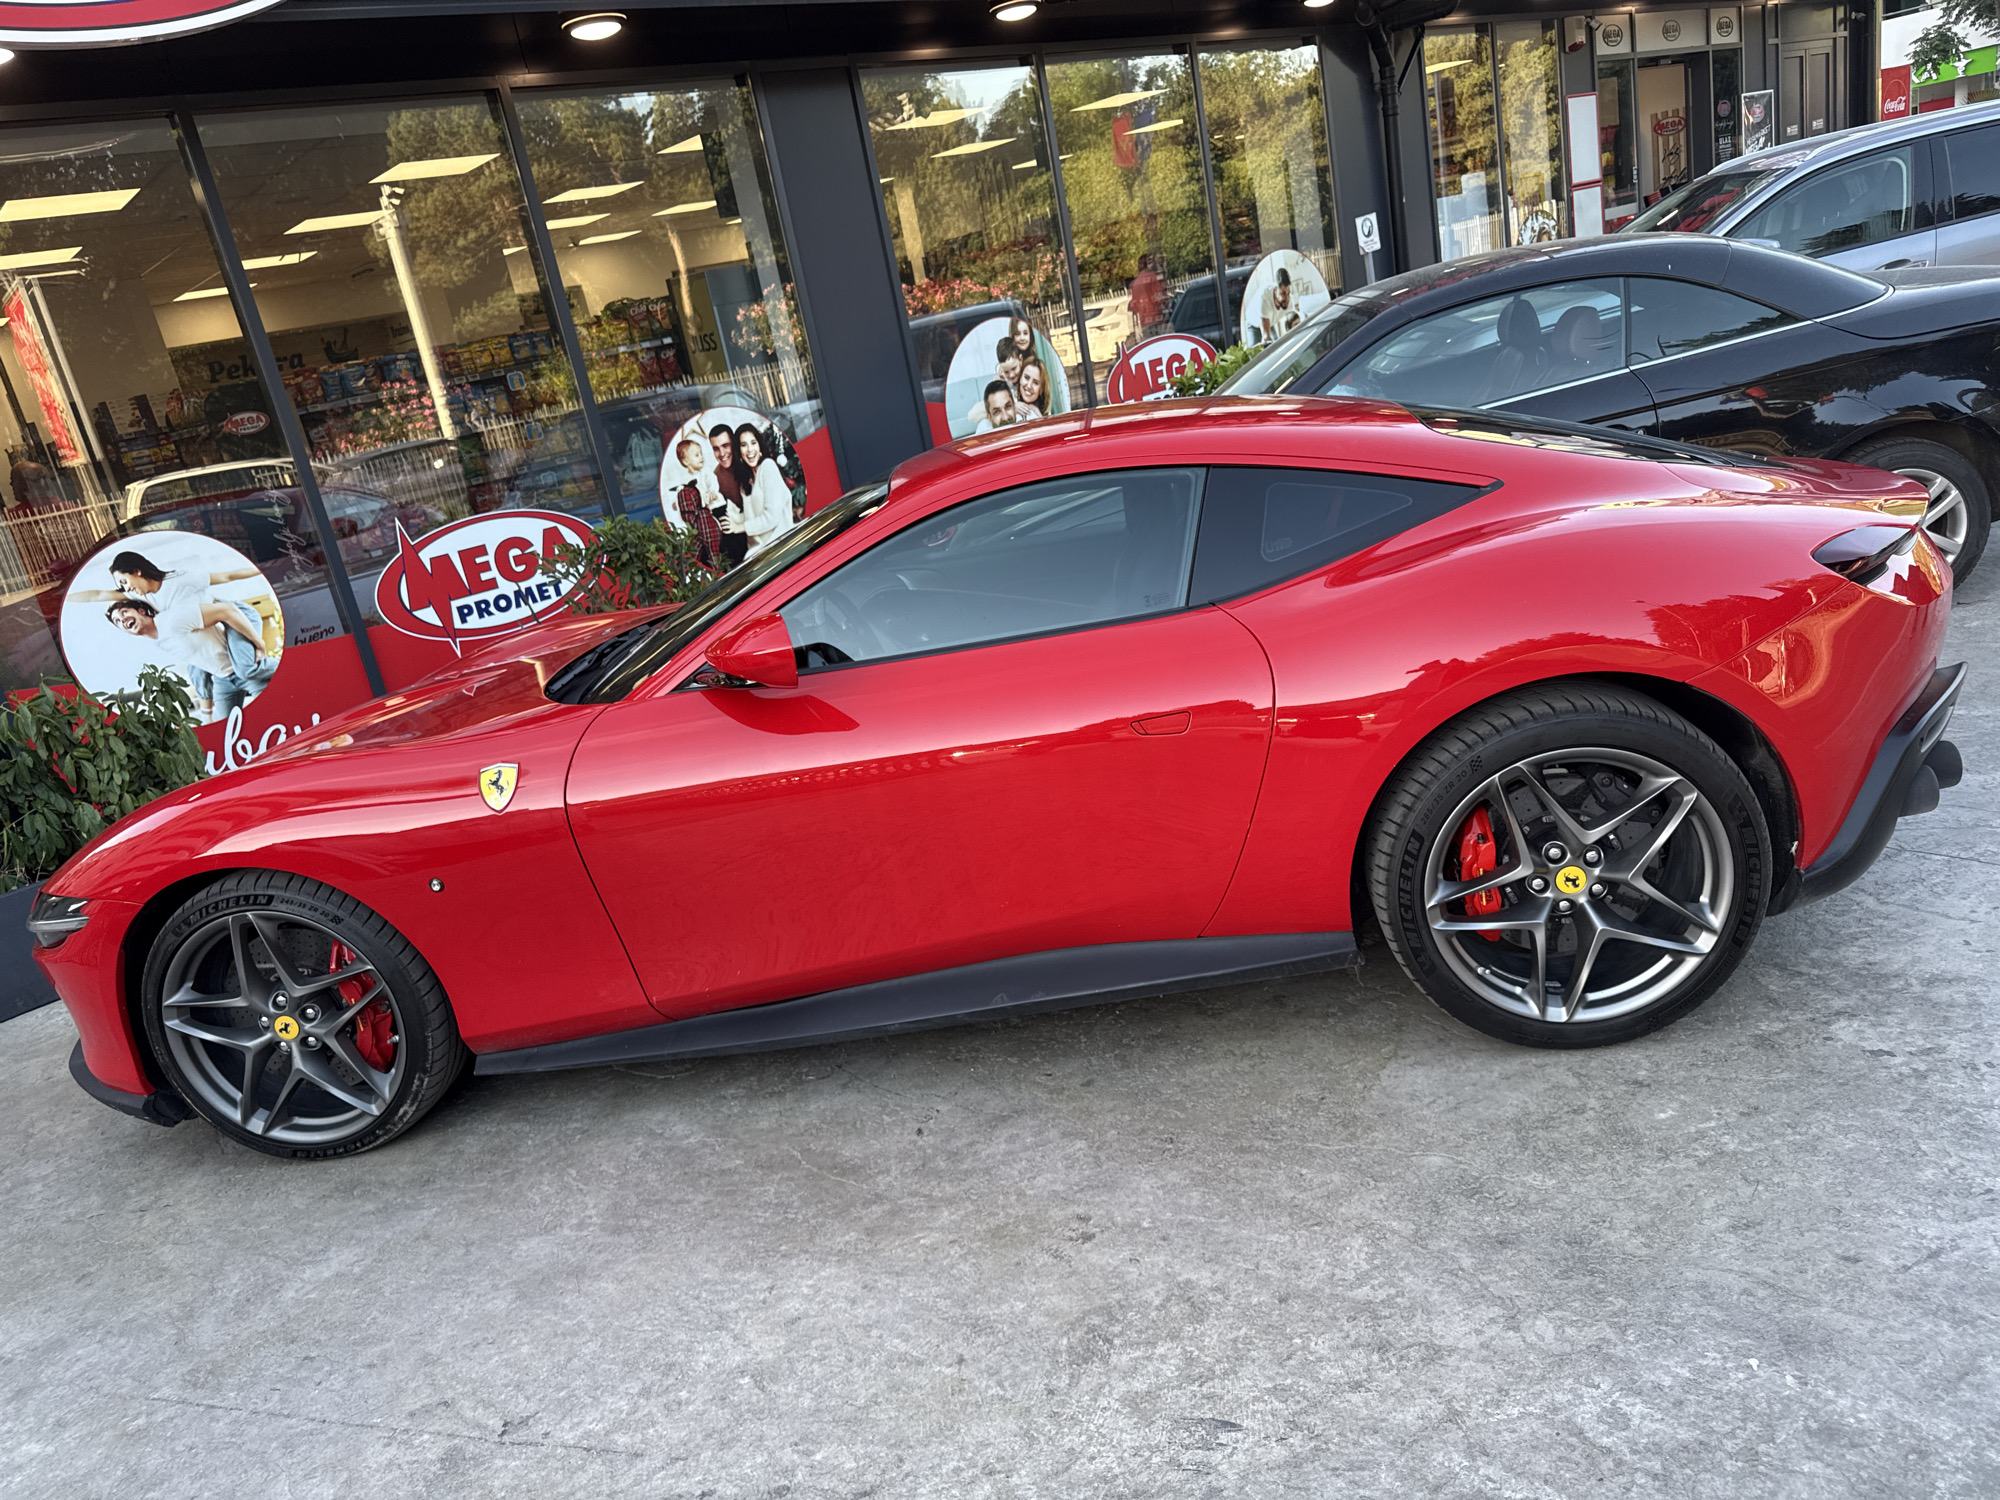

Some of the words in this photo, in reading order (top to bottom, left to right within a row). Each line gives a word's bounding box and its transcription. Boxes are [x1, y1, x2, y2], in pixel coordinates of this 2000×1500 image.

[207, 352, 306, 384] Pekra
[1121, 344, 1206, 402] MEGA
[398, 522, 573, 635] MEGA
[456, 580, 563, 625] PROMET
[1456, 770, 1468, 783] 20
[189, 894, 269, 924] MICHELIN
[1399, 836, 1422, 948] MICHELIN
[1735, 826, 1761, 941] MICHELIN
